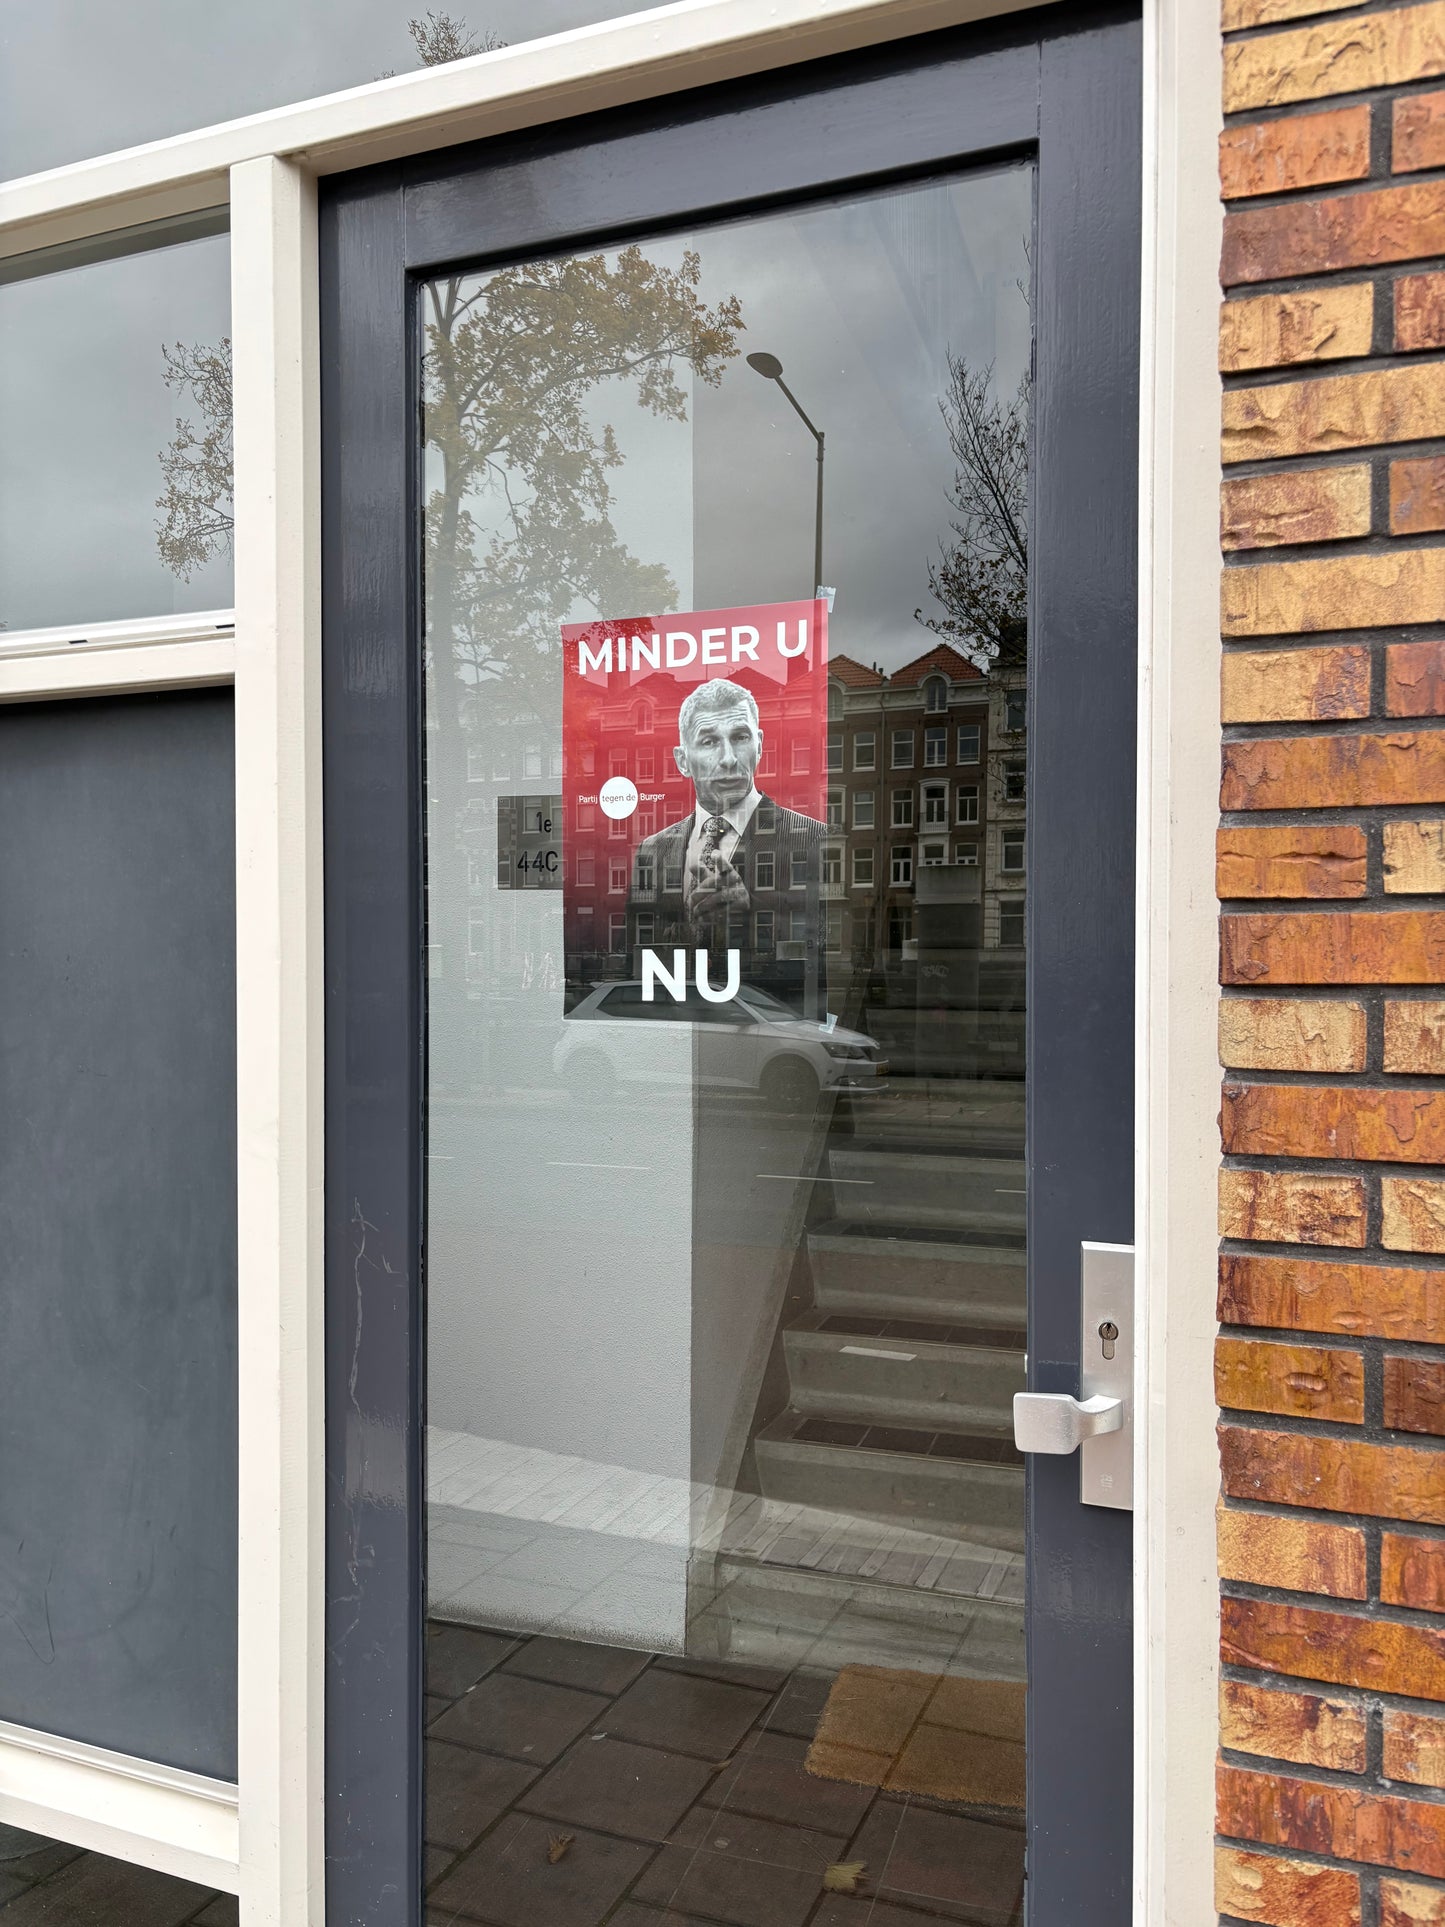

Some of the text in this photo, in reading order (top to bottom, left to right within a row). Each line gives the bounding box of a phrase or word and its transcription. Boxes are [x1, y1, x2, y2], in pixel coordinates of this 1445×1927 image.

[577, 619, 809, 675] MINDER U
[578, 793, 666, 805] Partij tegen de Burger
[536, 811, 552, 832] 1e
[517, 851, 558, 872] 44C
[641, 948, 741, 1004] NU
